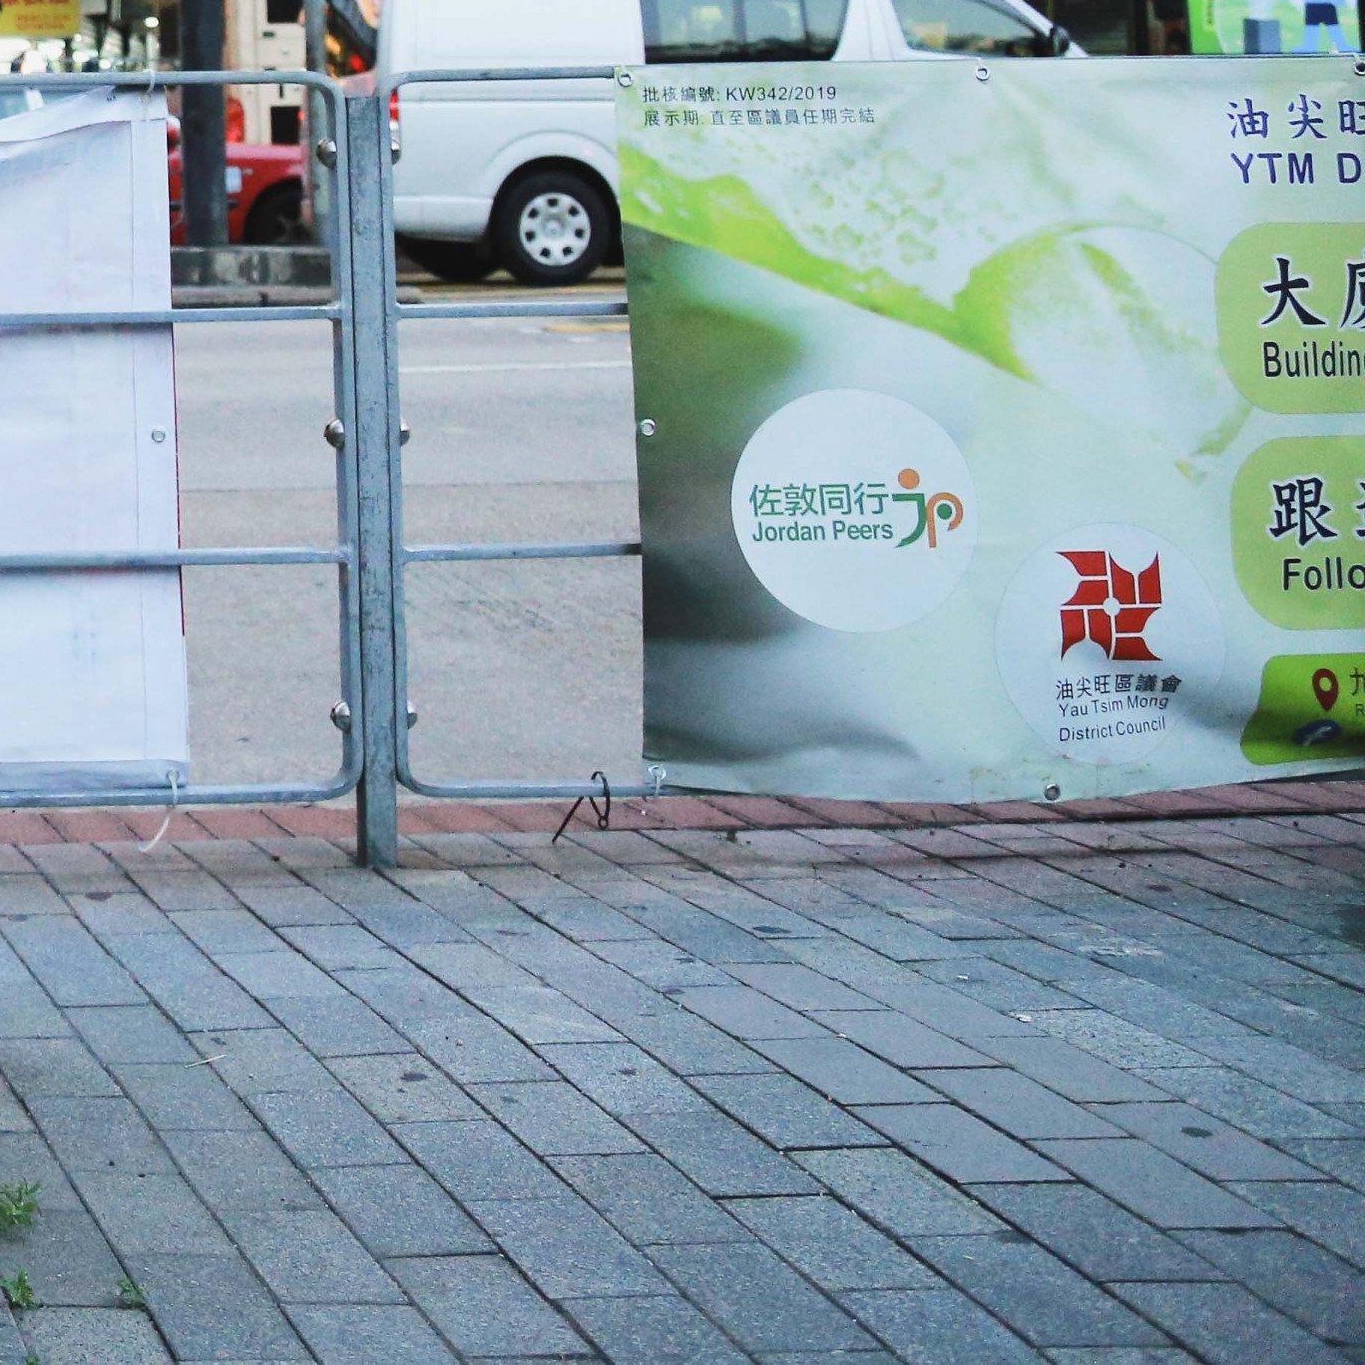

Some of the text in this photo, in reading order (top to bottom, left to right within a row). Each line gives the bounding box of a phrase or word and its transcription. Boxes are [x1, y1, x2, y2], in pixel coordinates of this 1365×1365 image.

[642, 85, 837, 103] 批核編號: KW342/2019
[711, 108, 876, 126] 直至區議員任期完結
[1230, 152, 1314, 185] YTM
[1263, 340, 1365, 378] Buildin
[749, 482, 889, 518] 佐敦同行
[1269, 477, 1365, 547] 跟
[751, 519, 894, 543] Jordan Peers
[1055, 674, 1183, 701] 油尖旺區議會
[1058, 694, 1170, 718] Yau Tsim Mong
[1059, 716, 1167, 743] District Council
